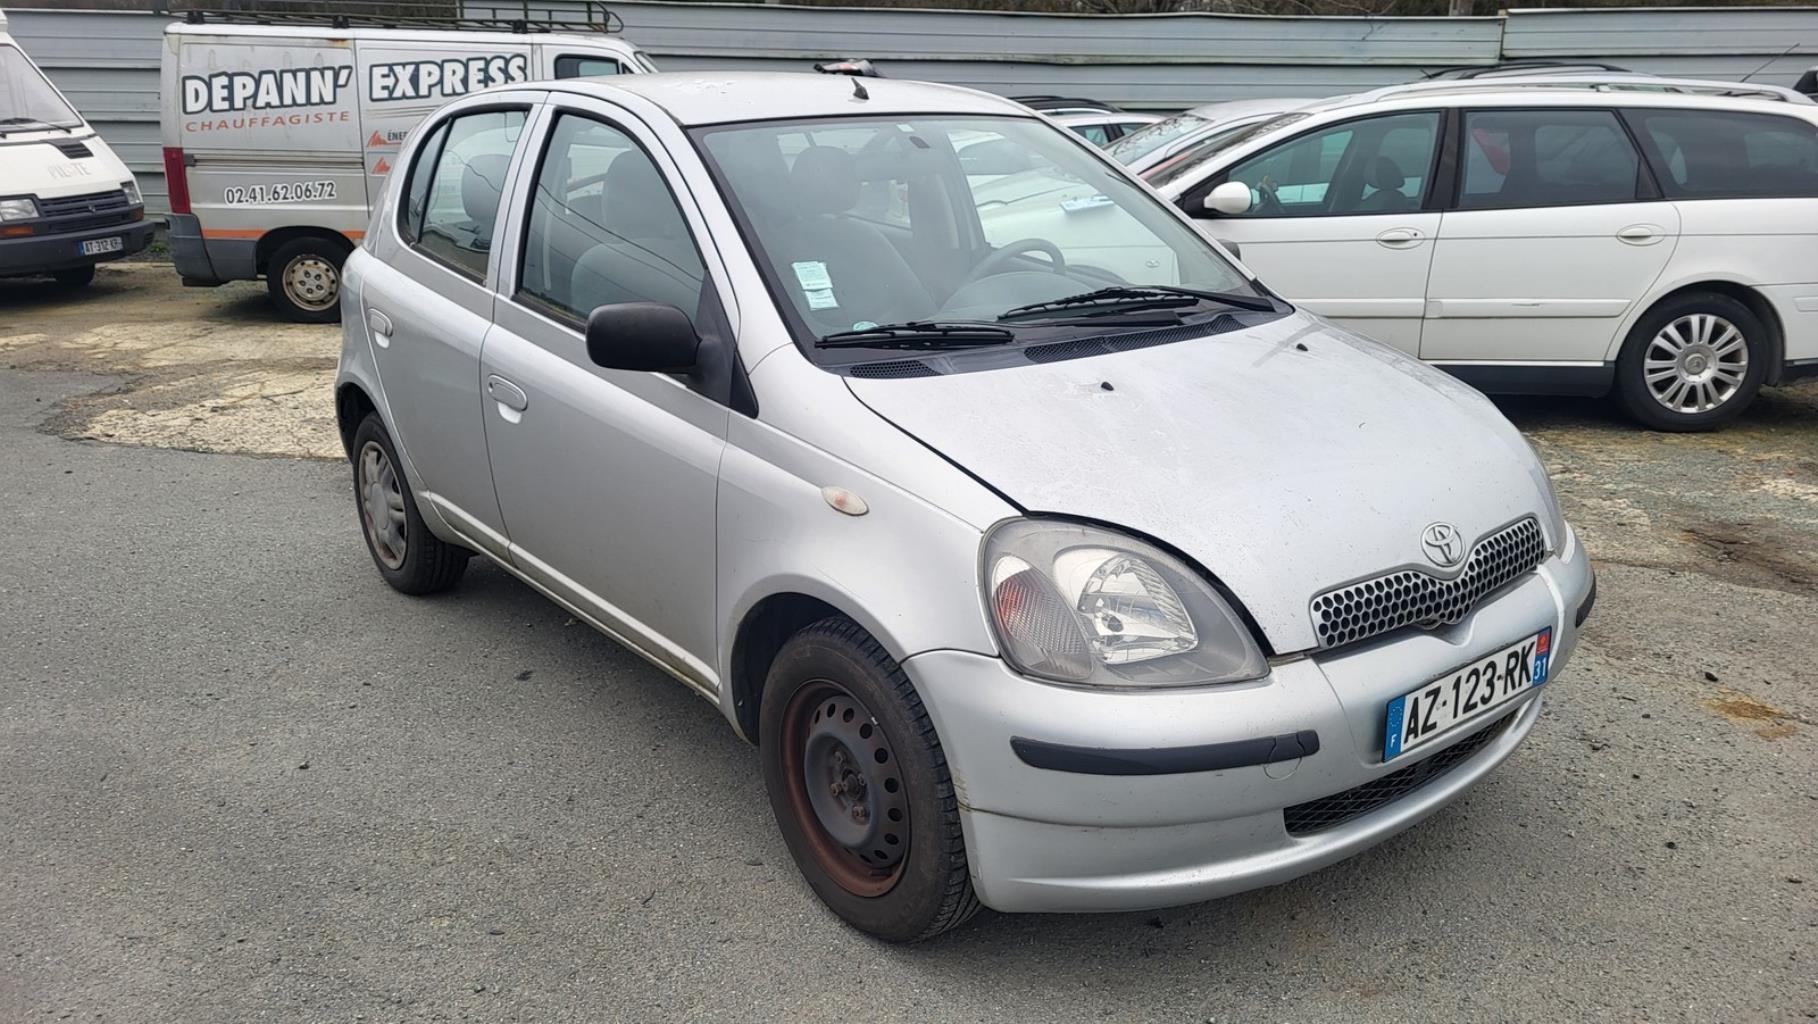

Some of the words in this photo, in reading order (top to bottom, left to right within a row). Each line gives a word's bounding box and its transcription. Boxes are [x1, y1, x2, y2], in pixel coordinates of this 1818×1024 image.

[369, 54, 527, 101] EXPRESS
[185, 111, 350, 132] CHAUFFAGISTE
[226, 182, 336, 204] 02.41.62.06.72
[1534, 656, 1547, 680] 31
[1403, 640, 1536, 744] AZ-123-RK
[1390, 733, 1397, 748] F
